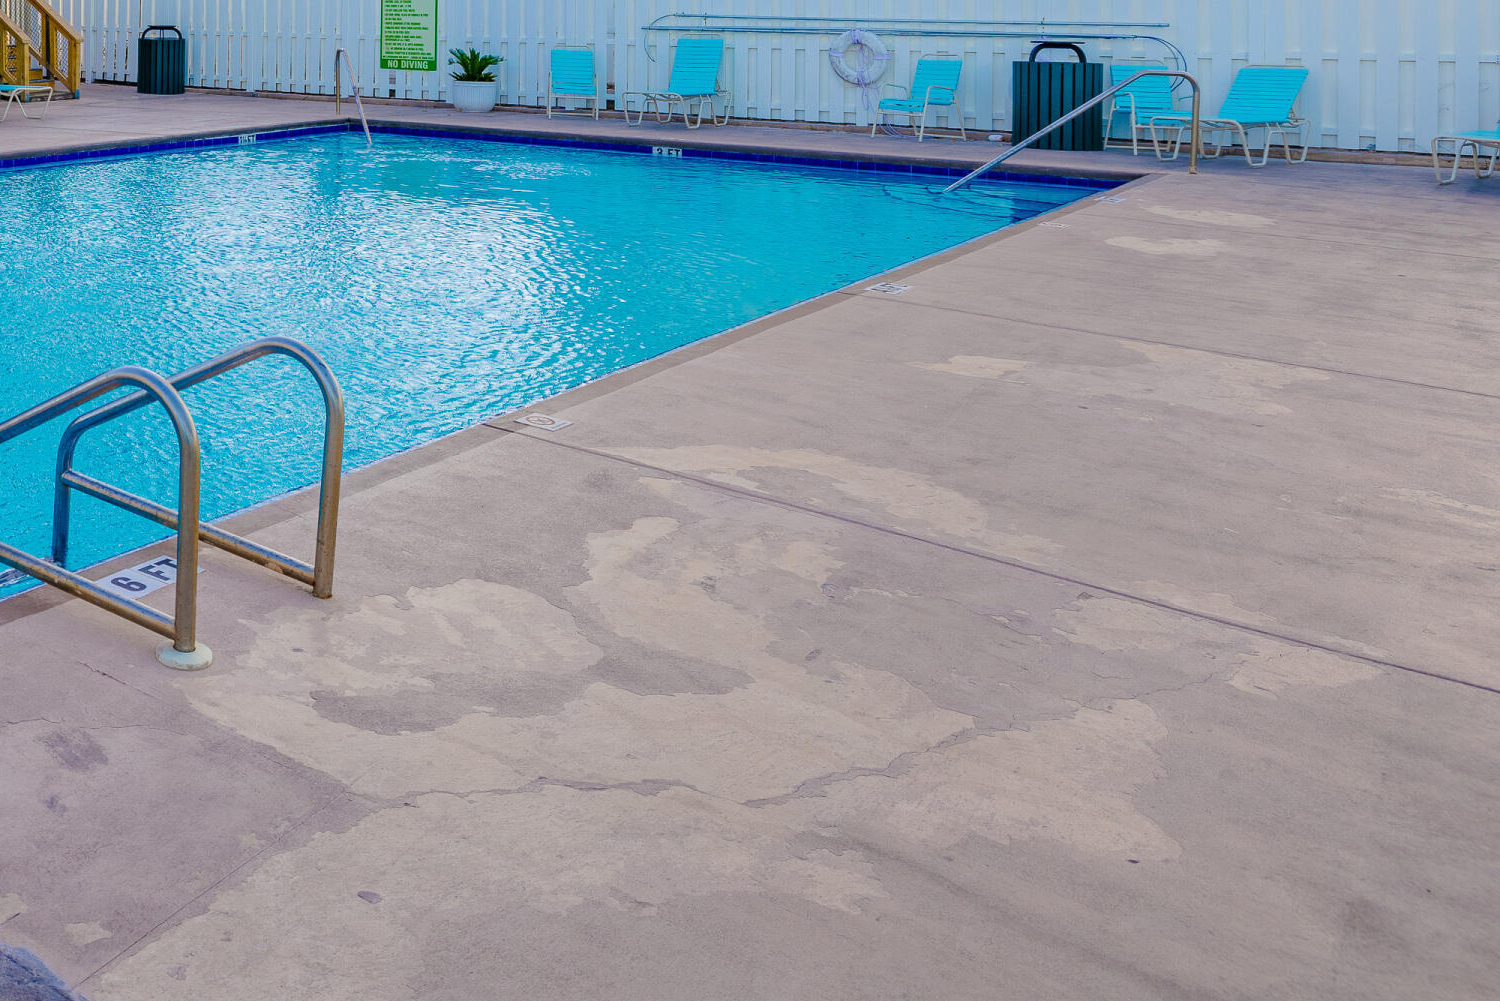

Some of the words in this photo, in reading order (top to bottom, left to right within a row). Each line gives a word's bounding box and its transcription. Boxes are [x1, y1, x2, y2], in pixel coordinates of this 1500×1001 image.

[387, 60, 398, 68] NO
[401, 60, 428, 69] DIVING
[667, 148, 680, 156] FT
[110, 576, 147, 592] 6
[138, 558, 178, 581] FT
